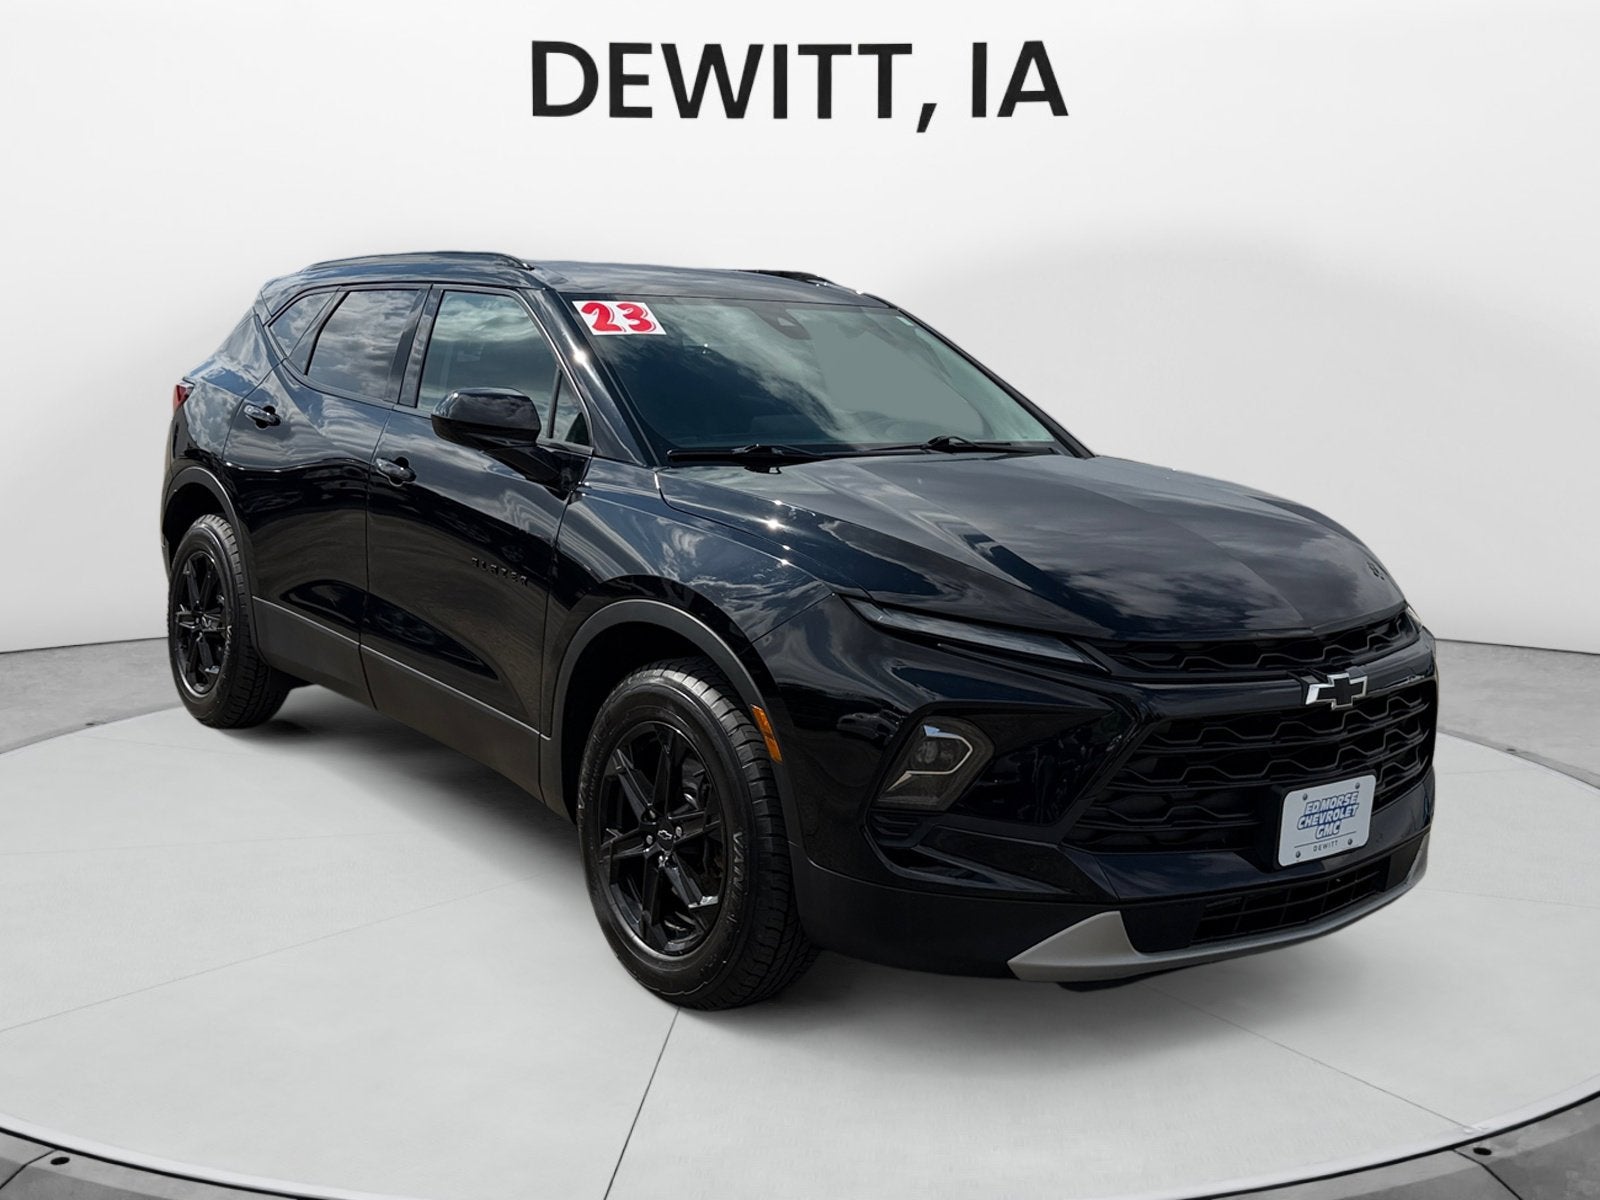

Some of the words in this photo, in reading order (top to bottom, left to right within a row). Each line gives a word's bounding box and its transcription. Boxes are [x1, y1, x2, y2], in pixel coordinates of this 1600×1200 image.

[580, 302, 657, 332] 23
[1304, 800, 1322, 815] ED
[1321, 791, 1359, 812] MORSE
[1297, 804, 1359, 830] CHEVROLET
[1315, 820, 1342, 840] GMC
[1312, 840, 1339, 852] DEWITT
